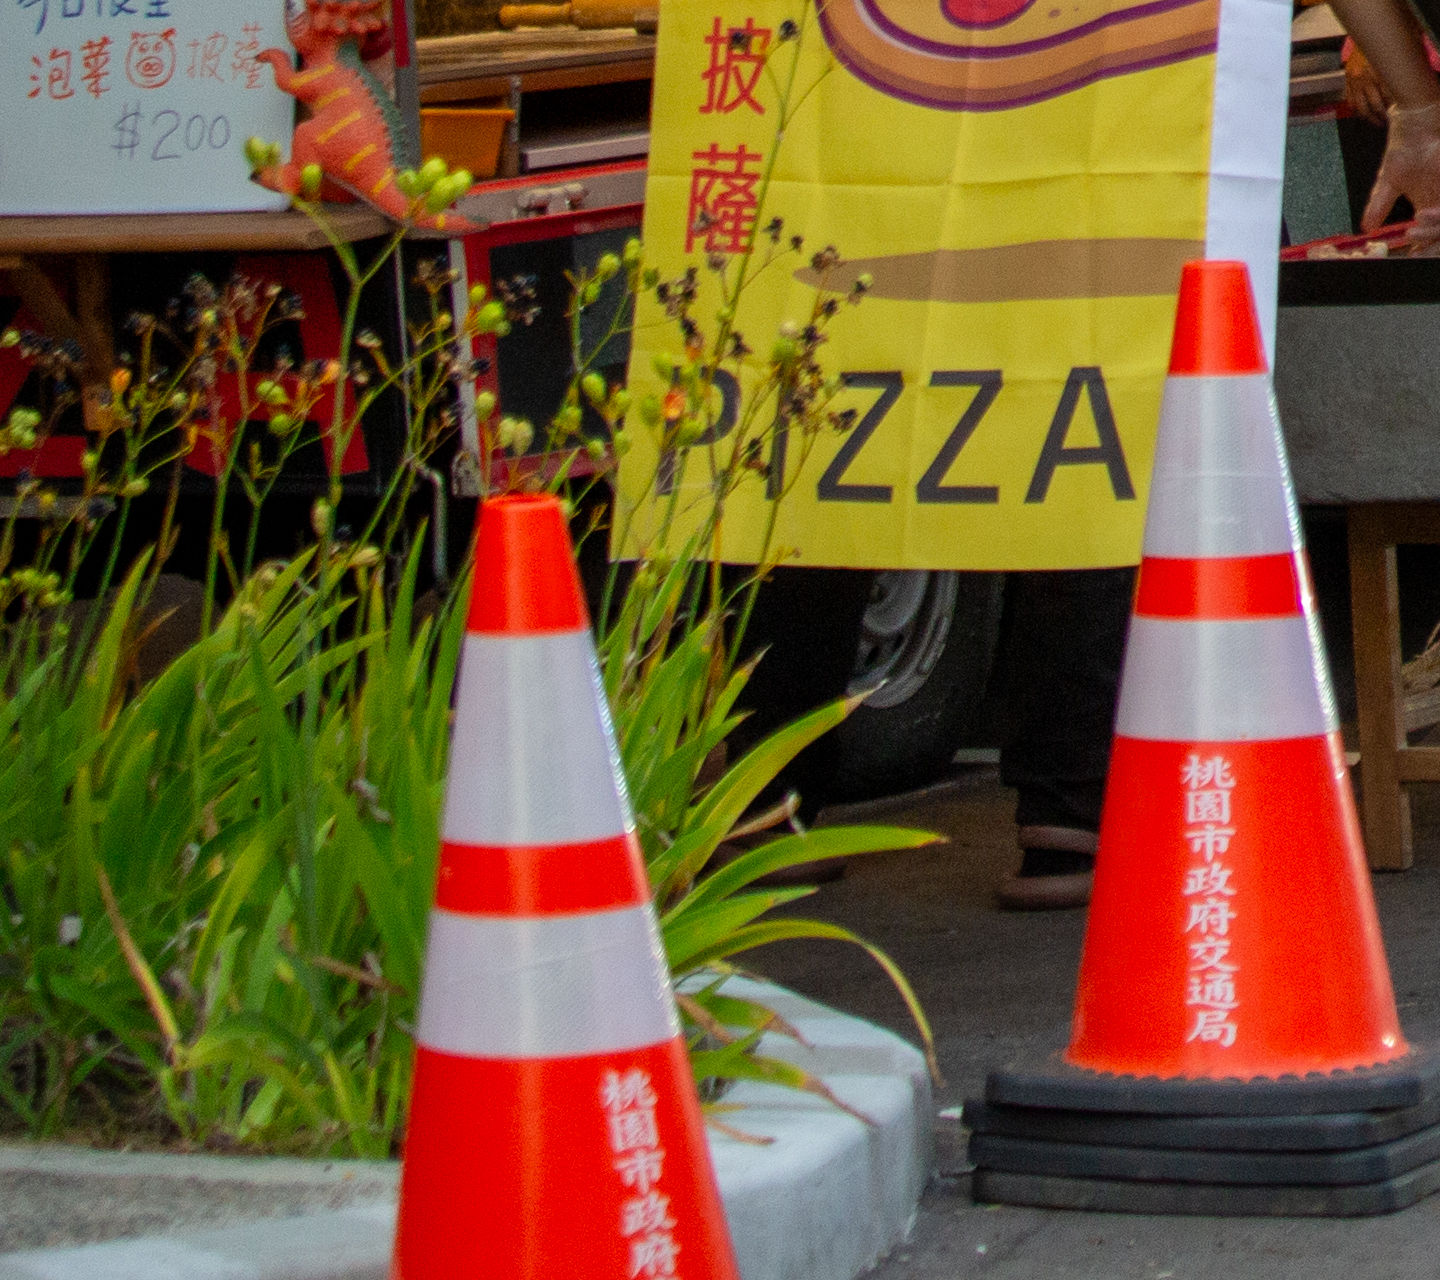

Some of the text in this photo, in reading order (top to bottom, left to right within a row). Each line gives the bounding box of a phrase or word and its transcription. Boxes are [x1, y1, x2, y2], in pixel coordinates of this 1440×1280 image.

[26, 35, 114, 100] 泡菜
[110, 101, 231, 161] $200
[655, 365, 1137, 505] PIZZA
[1181, 753, 1241, 1050] 桃園市政府交通局
[600, 1067, 684, 1280] 桃園市政府
